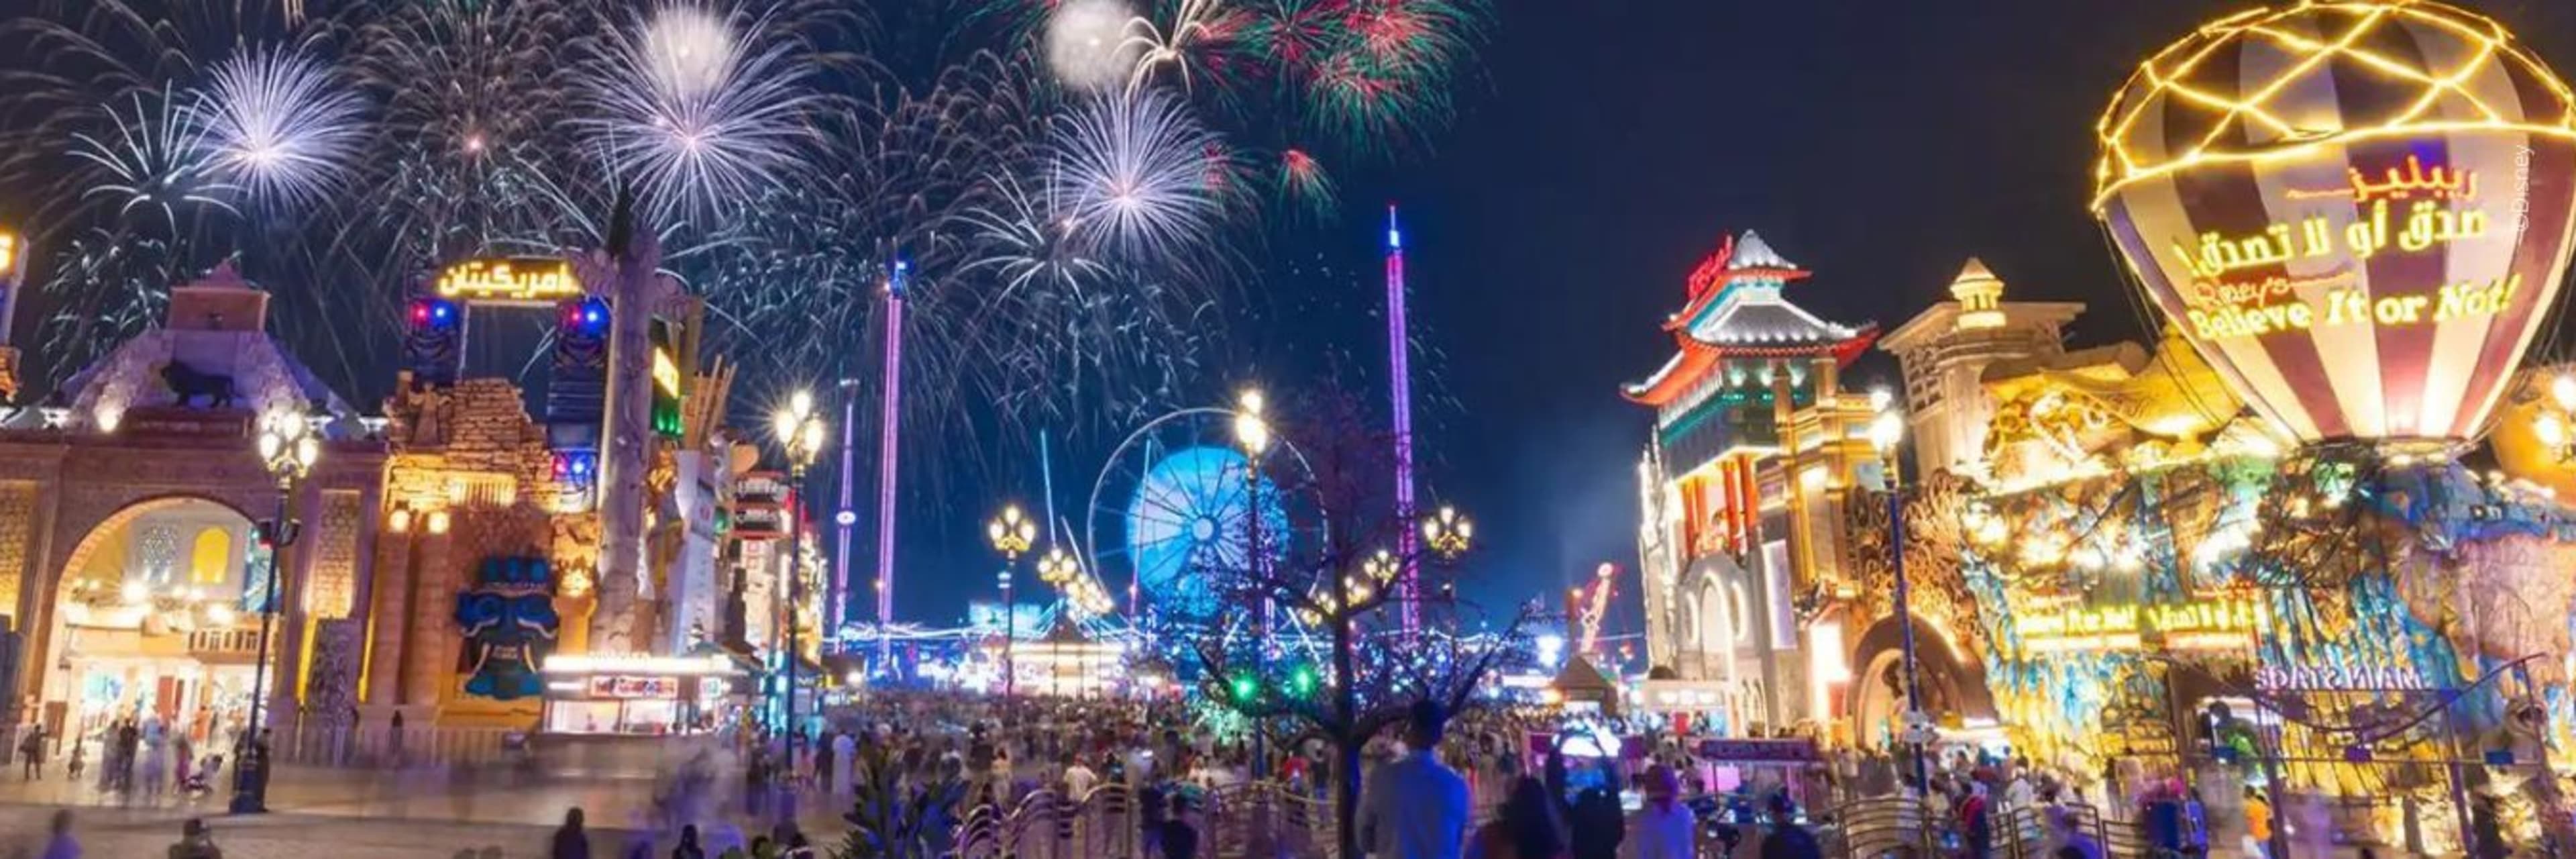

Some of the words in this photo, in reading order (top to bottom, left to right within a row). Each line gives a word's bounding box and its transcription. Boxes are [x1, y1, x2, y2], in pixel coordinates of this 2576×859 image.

[2188, 302, 2312, 339] Believe
[2325, 289, 2366, 326] It
[2375, 295, 2427, 325] or
[2432, 273, 2522, 322] Not!
